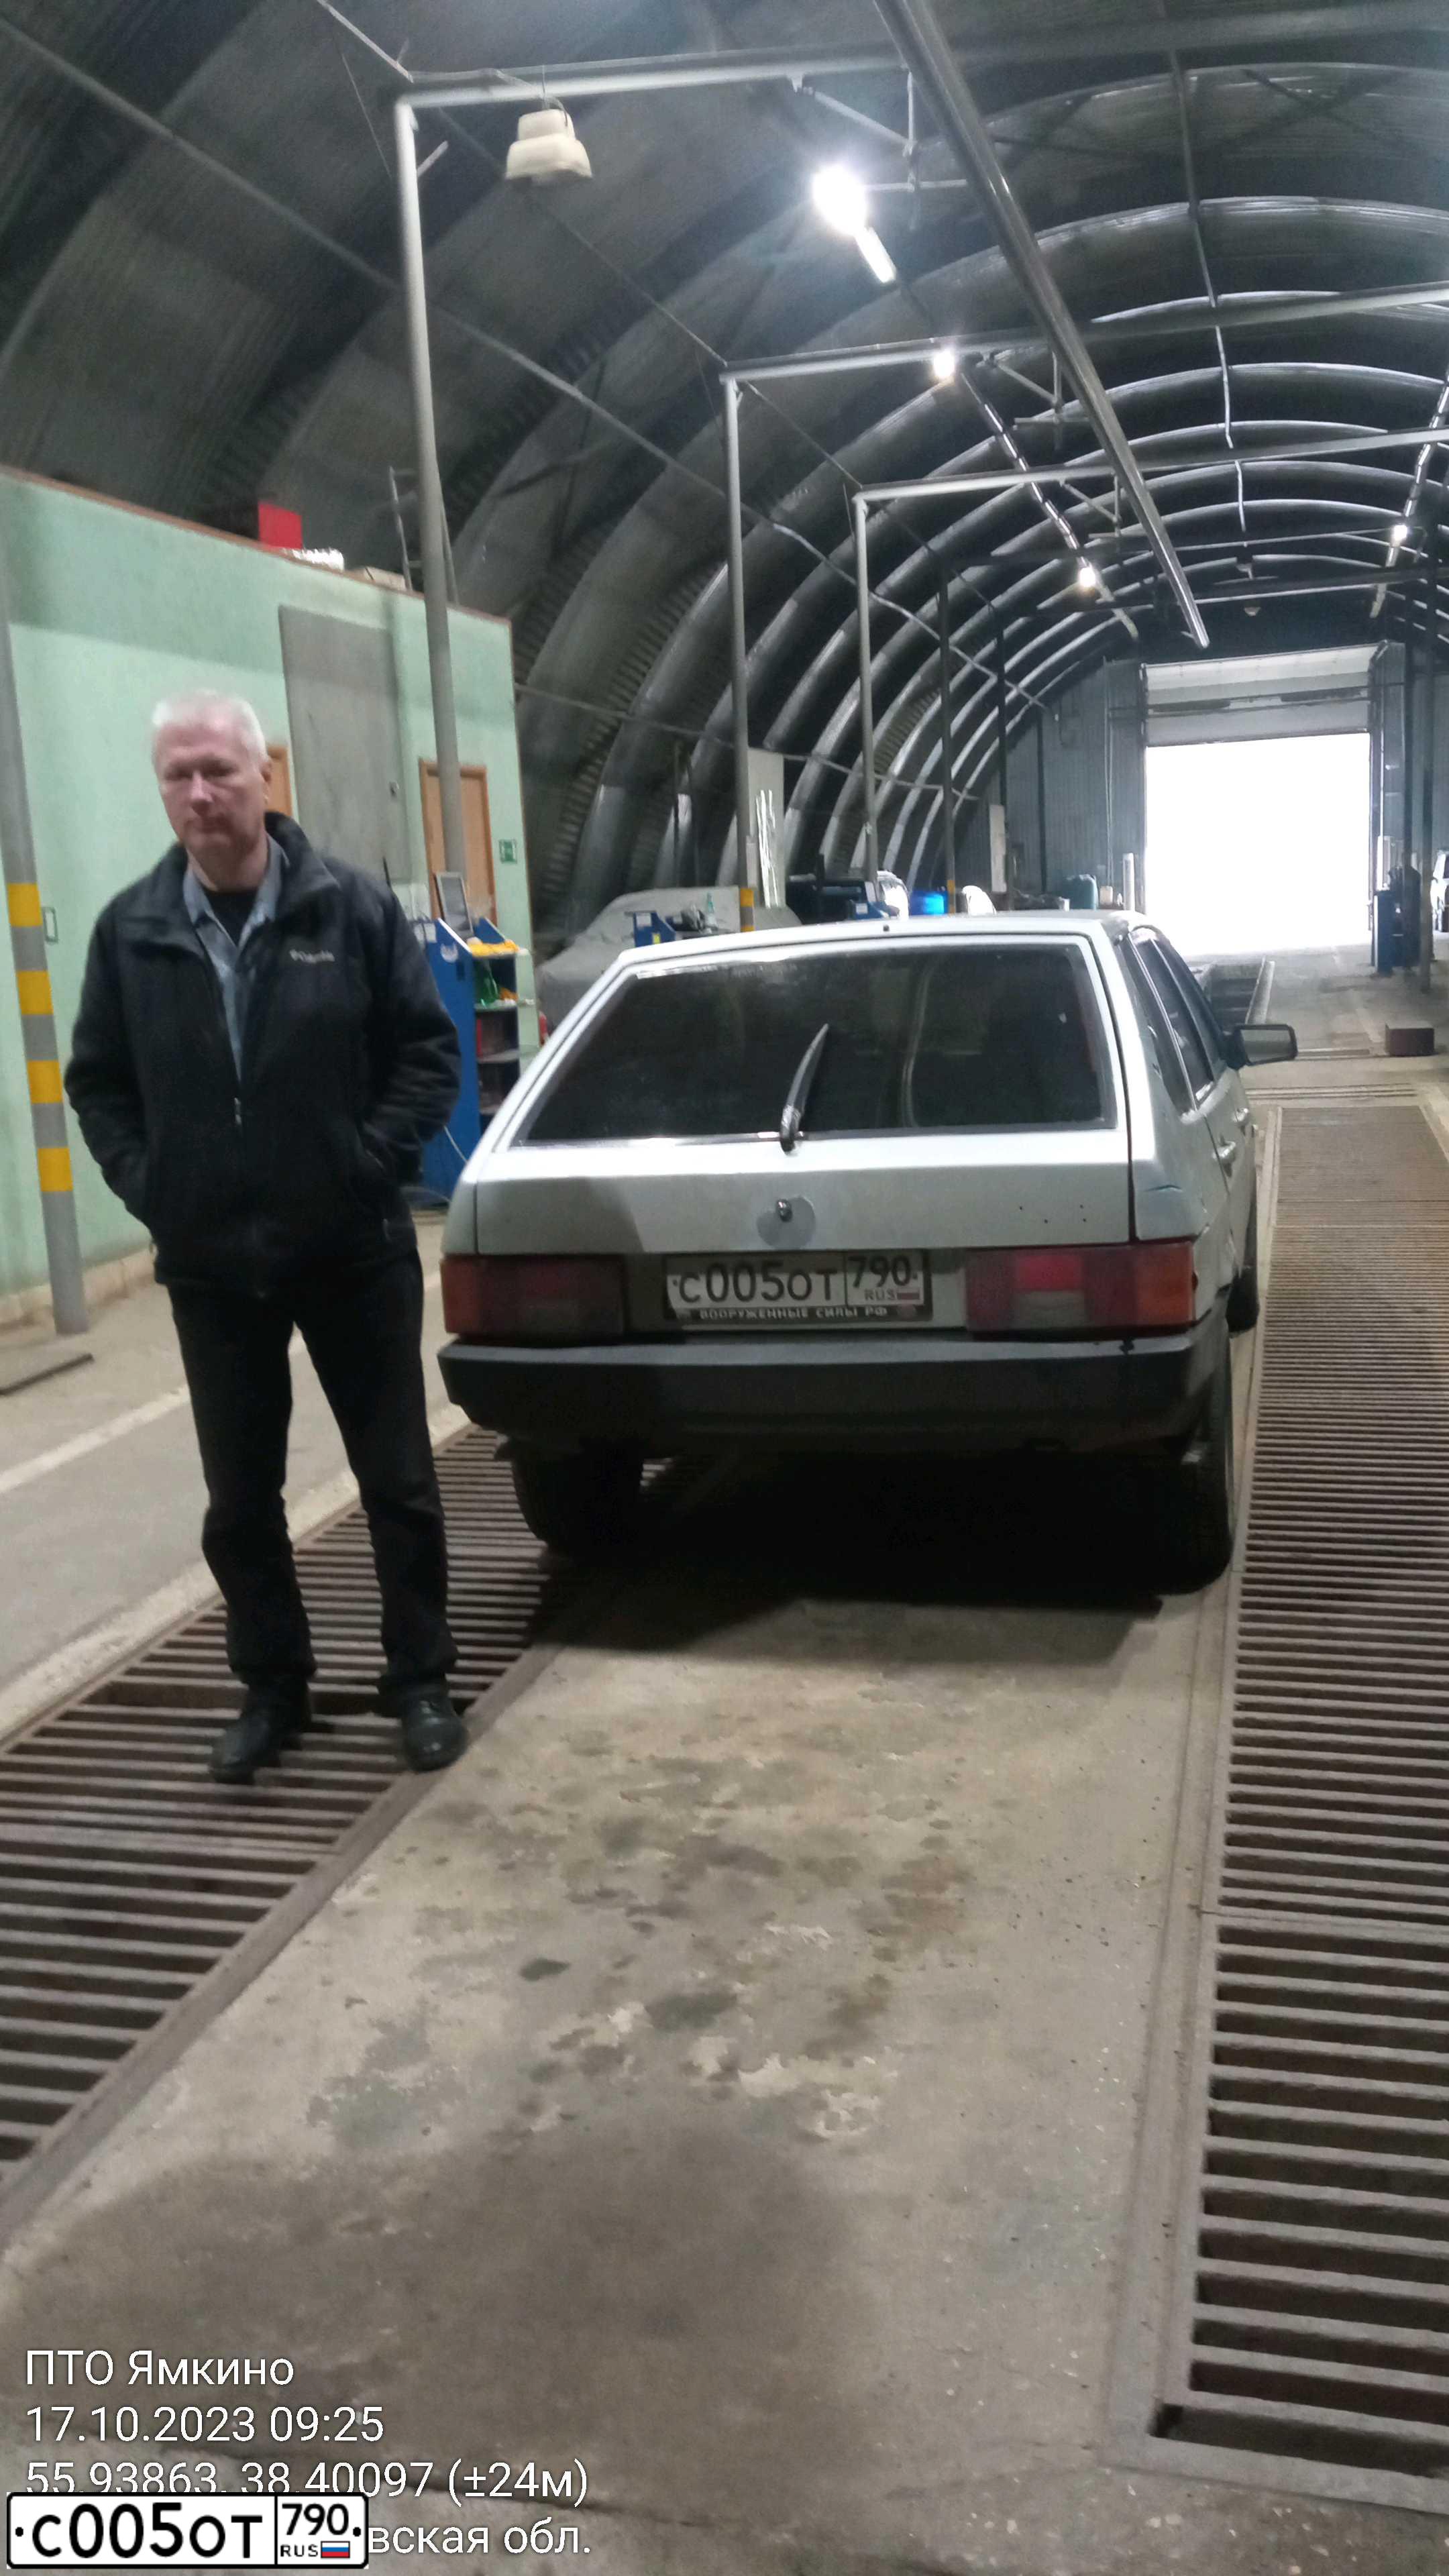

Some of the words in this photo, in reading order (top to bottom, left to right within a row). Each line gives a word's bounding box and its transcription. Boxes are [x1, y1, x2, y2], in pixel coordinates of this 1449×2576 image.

[848, 1254, 911, 1288] 790
[864, 1289, 897, 1301] RUS
[815, 1306, 858, 1319] СИЛЫ
[865, 1305, 888, 1317] РФ
